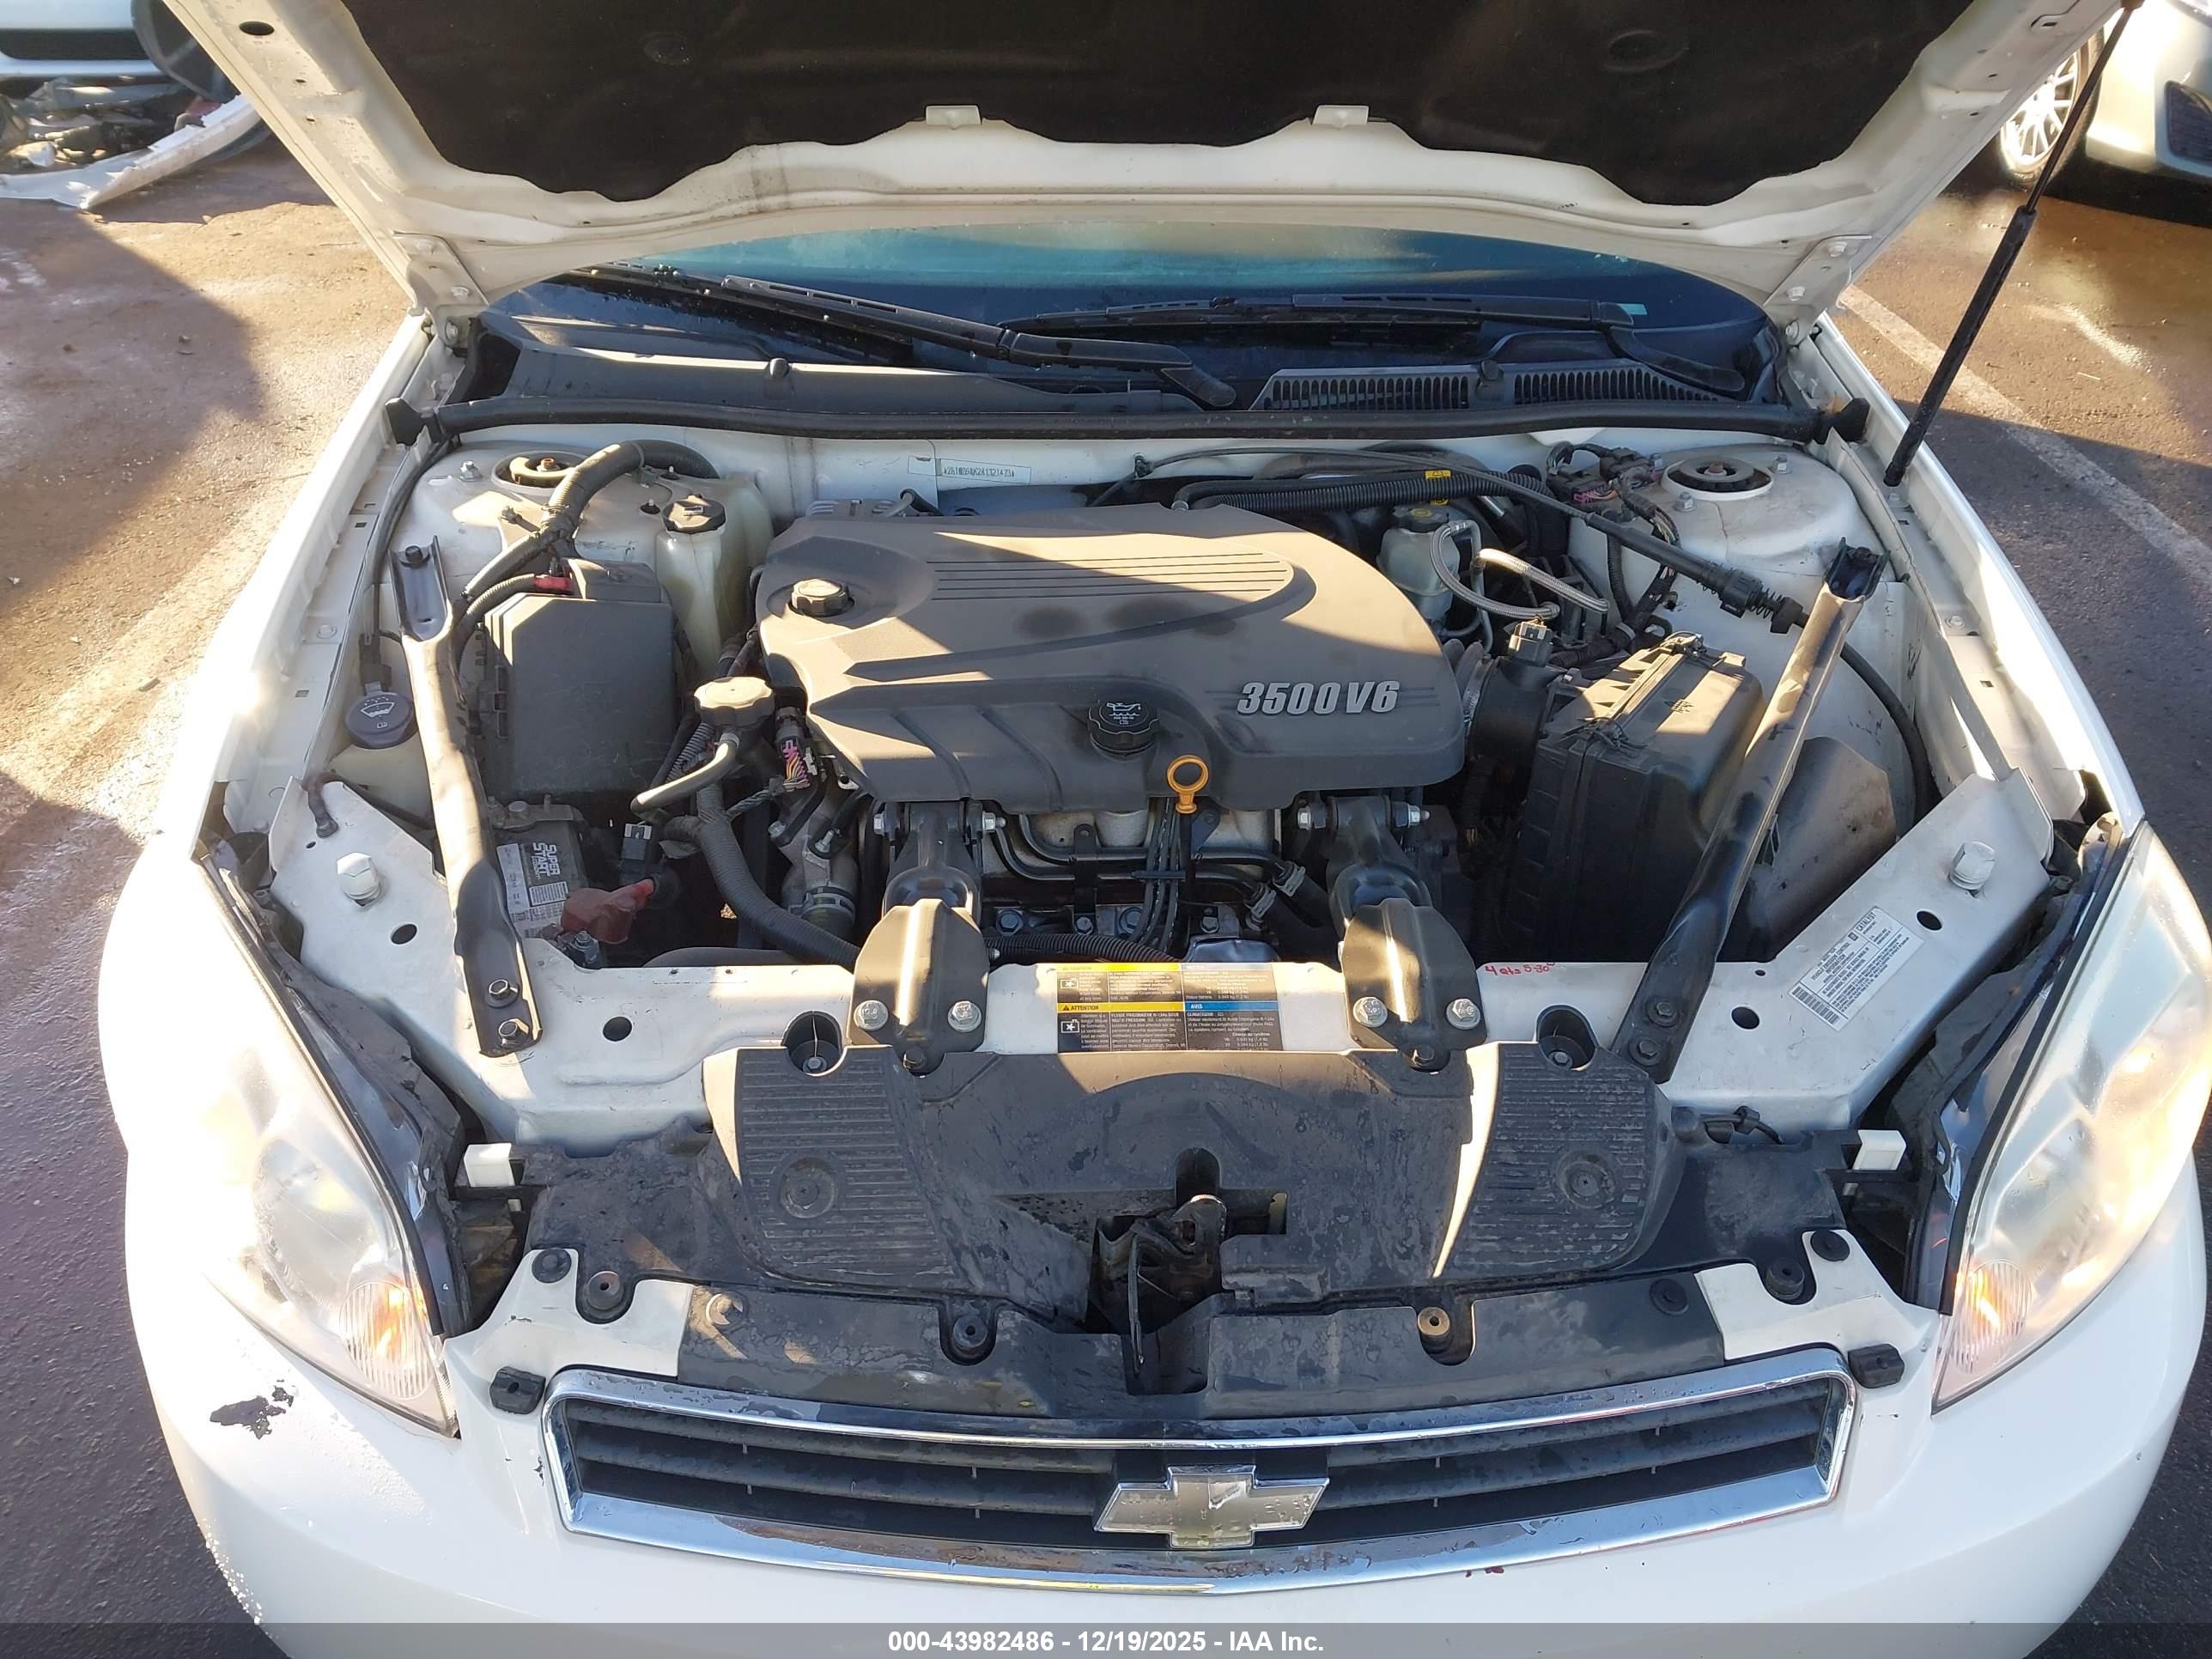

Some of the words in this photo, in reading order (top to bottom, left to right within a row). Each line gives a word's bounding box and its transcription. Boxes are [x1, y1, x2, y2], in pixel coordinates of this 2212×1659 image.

[1237, 682, 1341, 714] 3500
[1346, 680, 1400, 714] V6
[532, 842, 550, 877] START
[545, 844, 561, 875] SUPER
[1856, 911, 1876, 933] CATALYST
